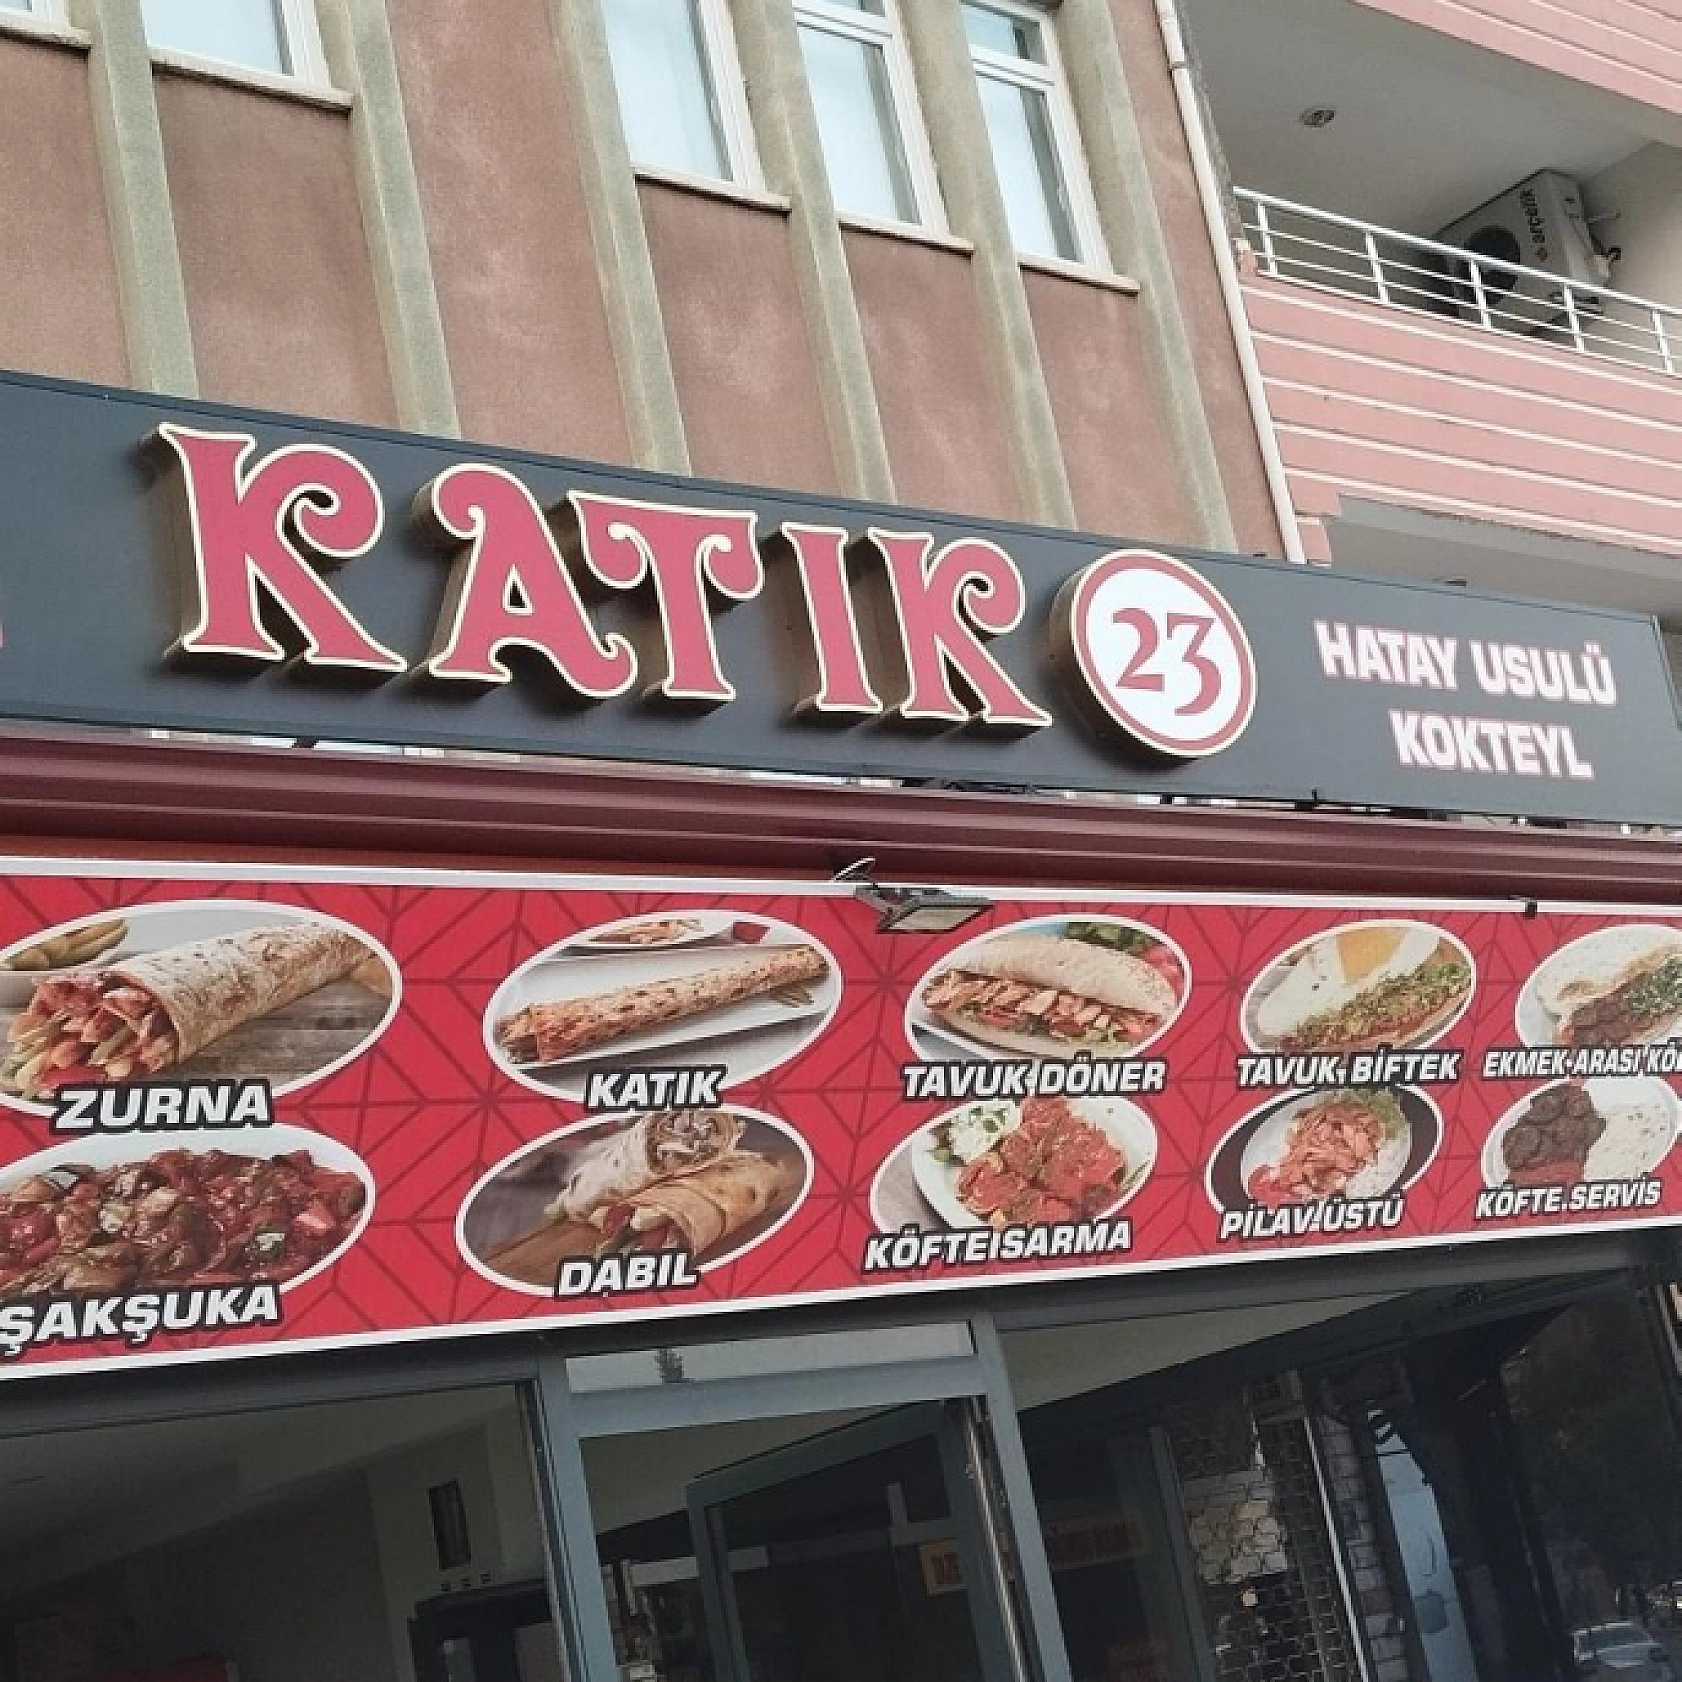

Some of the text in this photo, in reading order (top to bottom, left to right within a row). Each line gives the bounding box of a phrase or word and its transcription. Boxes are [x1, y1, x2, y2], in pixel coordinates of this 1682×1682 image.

[158, 422, 1052, 727] KATIK
[1111, 607, 1222, 717] 23
[1313, 620, 1617, 706] HATAY USULÜ
[1388, 709, 1595, 780] KOKTEYL
[903, 1054, 1167, 1098] TAVUK DÖNER
[1236, 1046, 1462, 1086] TAVUK BİFTEK
[1482, 1050, 1568, 1078] EKMEK
[1572, 1047, 1643, 1075] ARASI
[54, 1082, 270, 1131] ZURNA
[587, 1070, 723, 1108] KATIK
[1219, 1195, 1404, 1239] PİLAV ÜSTÜ
[1474, 1177, 1662, 1218] KÖFTE SERVİS
[863, 1219, 1132, 1271] KÖFTE SARMA
[558, 1253, 698, 1296] DABIL
[0, 1284, 279, 1357] ŞAKŞUKA
